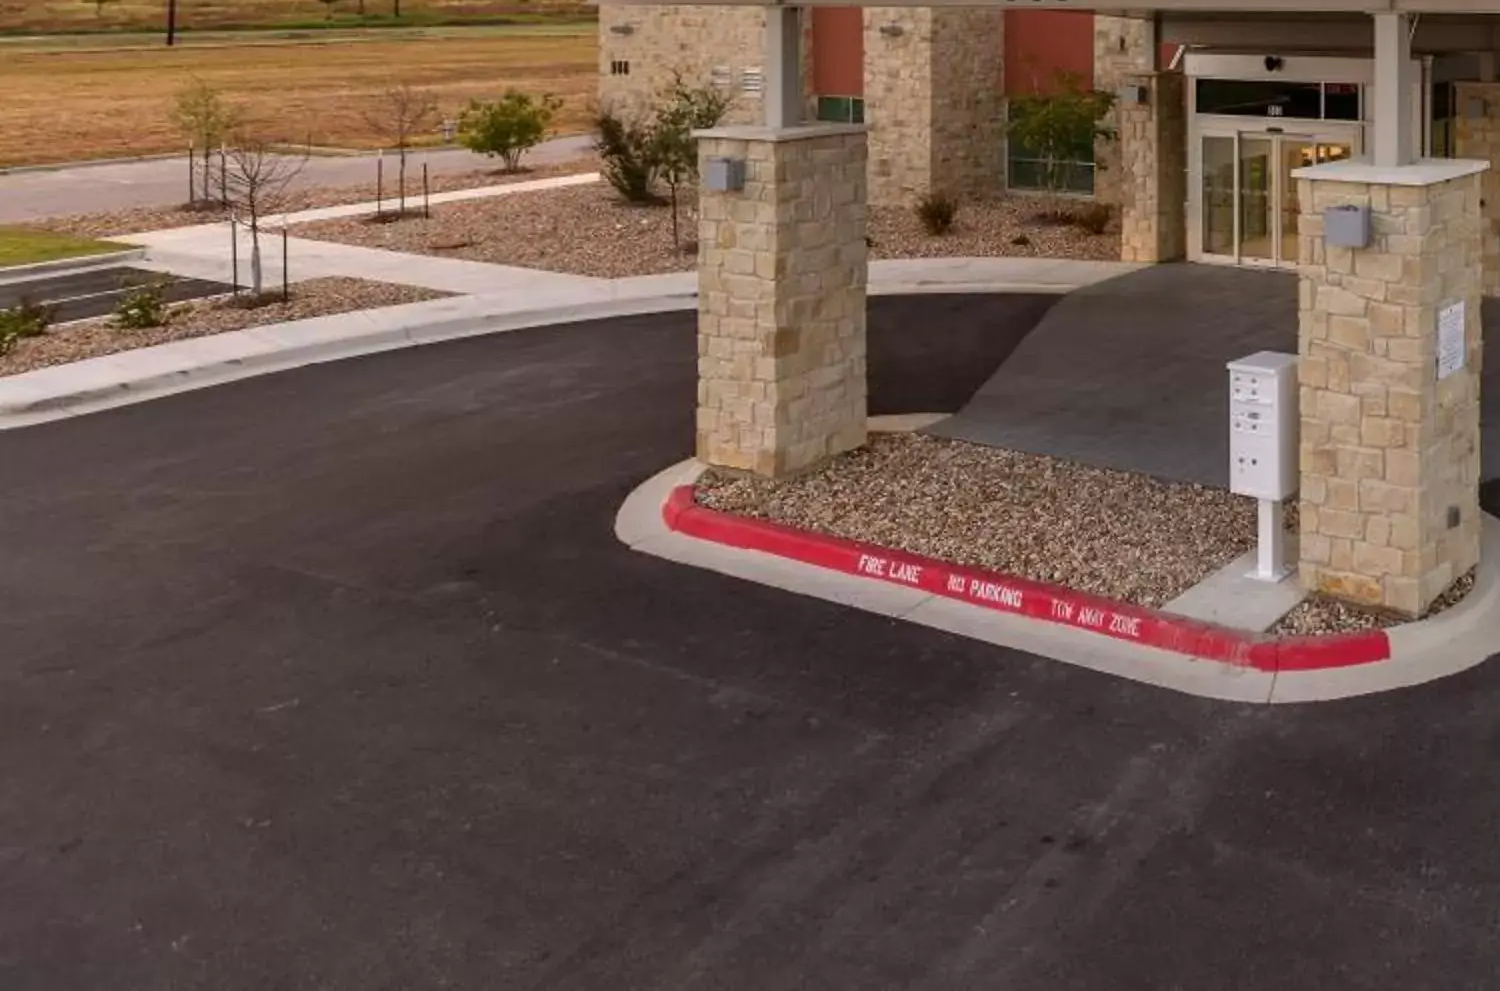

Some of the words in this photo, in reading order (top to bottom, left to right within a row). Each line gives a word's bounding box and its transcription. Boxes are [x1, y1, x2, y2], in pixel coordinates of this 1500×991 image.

[858, 554, 887, 576] FIRE
[889, 561, 924, 584] LANE
[947, 573, 966, 593] NO
[969, 579, 1023, 608] PARKING
[1051, 598, 1076, 620] TOW
[1109, 612, 1143, 637] ZONE
